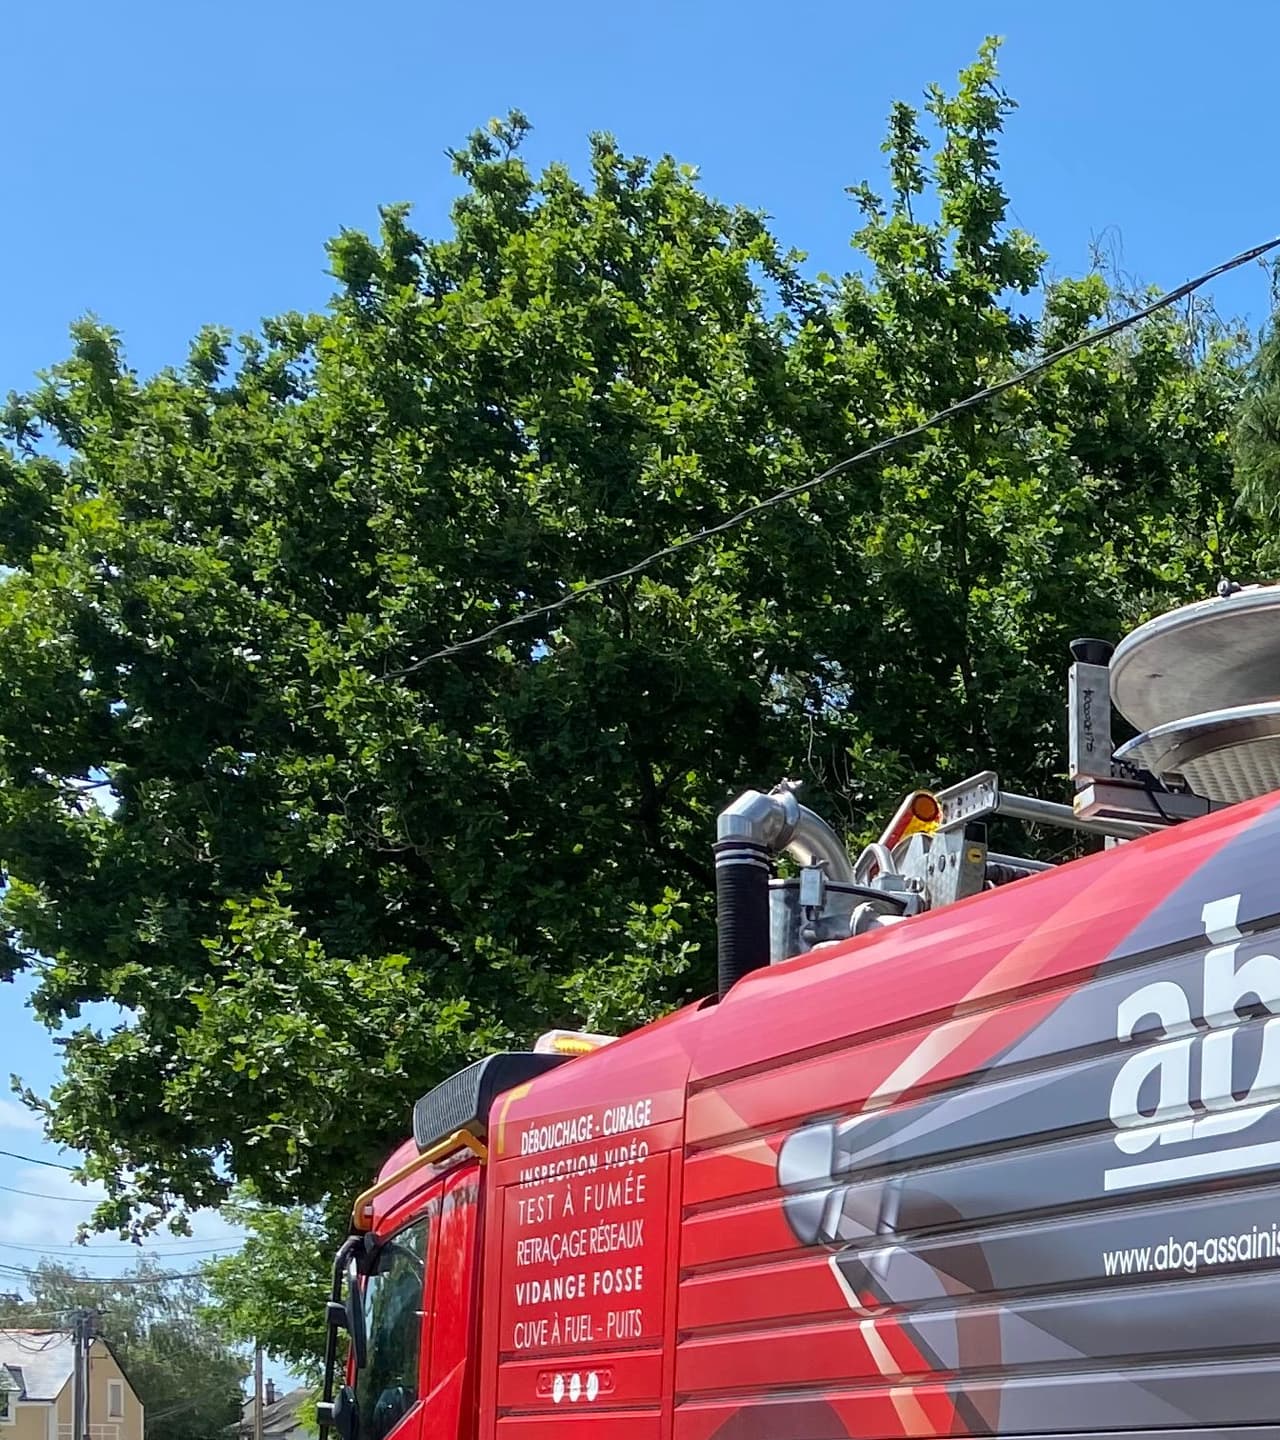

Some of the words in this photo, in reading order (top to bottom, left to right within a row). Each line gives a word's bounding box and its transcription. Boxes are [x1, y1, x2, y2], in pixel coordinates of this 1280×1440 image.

[521, 1114, 594, 1156] DÉBOUCHAGE
[602, 1098, 652, 1137] CURAGE
[519, 1153, 598, 1190] INSPECTION
[604, 1137, 649, 1170] VIDÉO
[518, 1193, 555, 1226] TEST
[562, 1183, 575, 1217] À
[584, 1169, 647, 1213] FUMÉE
[516, 1228, 587, 1267] RETRAÇAGE
[589, 1218, 644, 1255] RÉSEAUX
[515, 1273, 586, 1307] VIDANGE
[593, 1265, 643, 1296] FOSSE
[513, 1319, 548, 1349] CUVE
[551, 1311, 561, 1345] À
[564, 1314, 593, 1344] FUEL
[607, 1308, 642, 1339] PUITS
